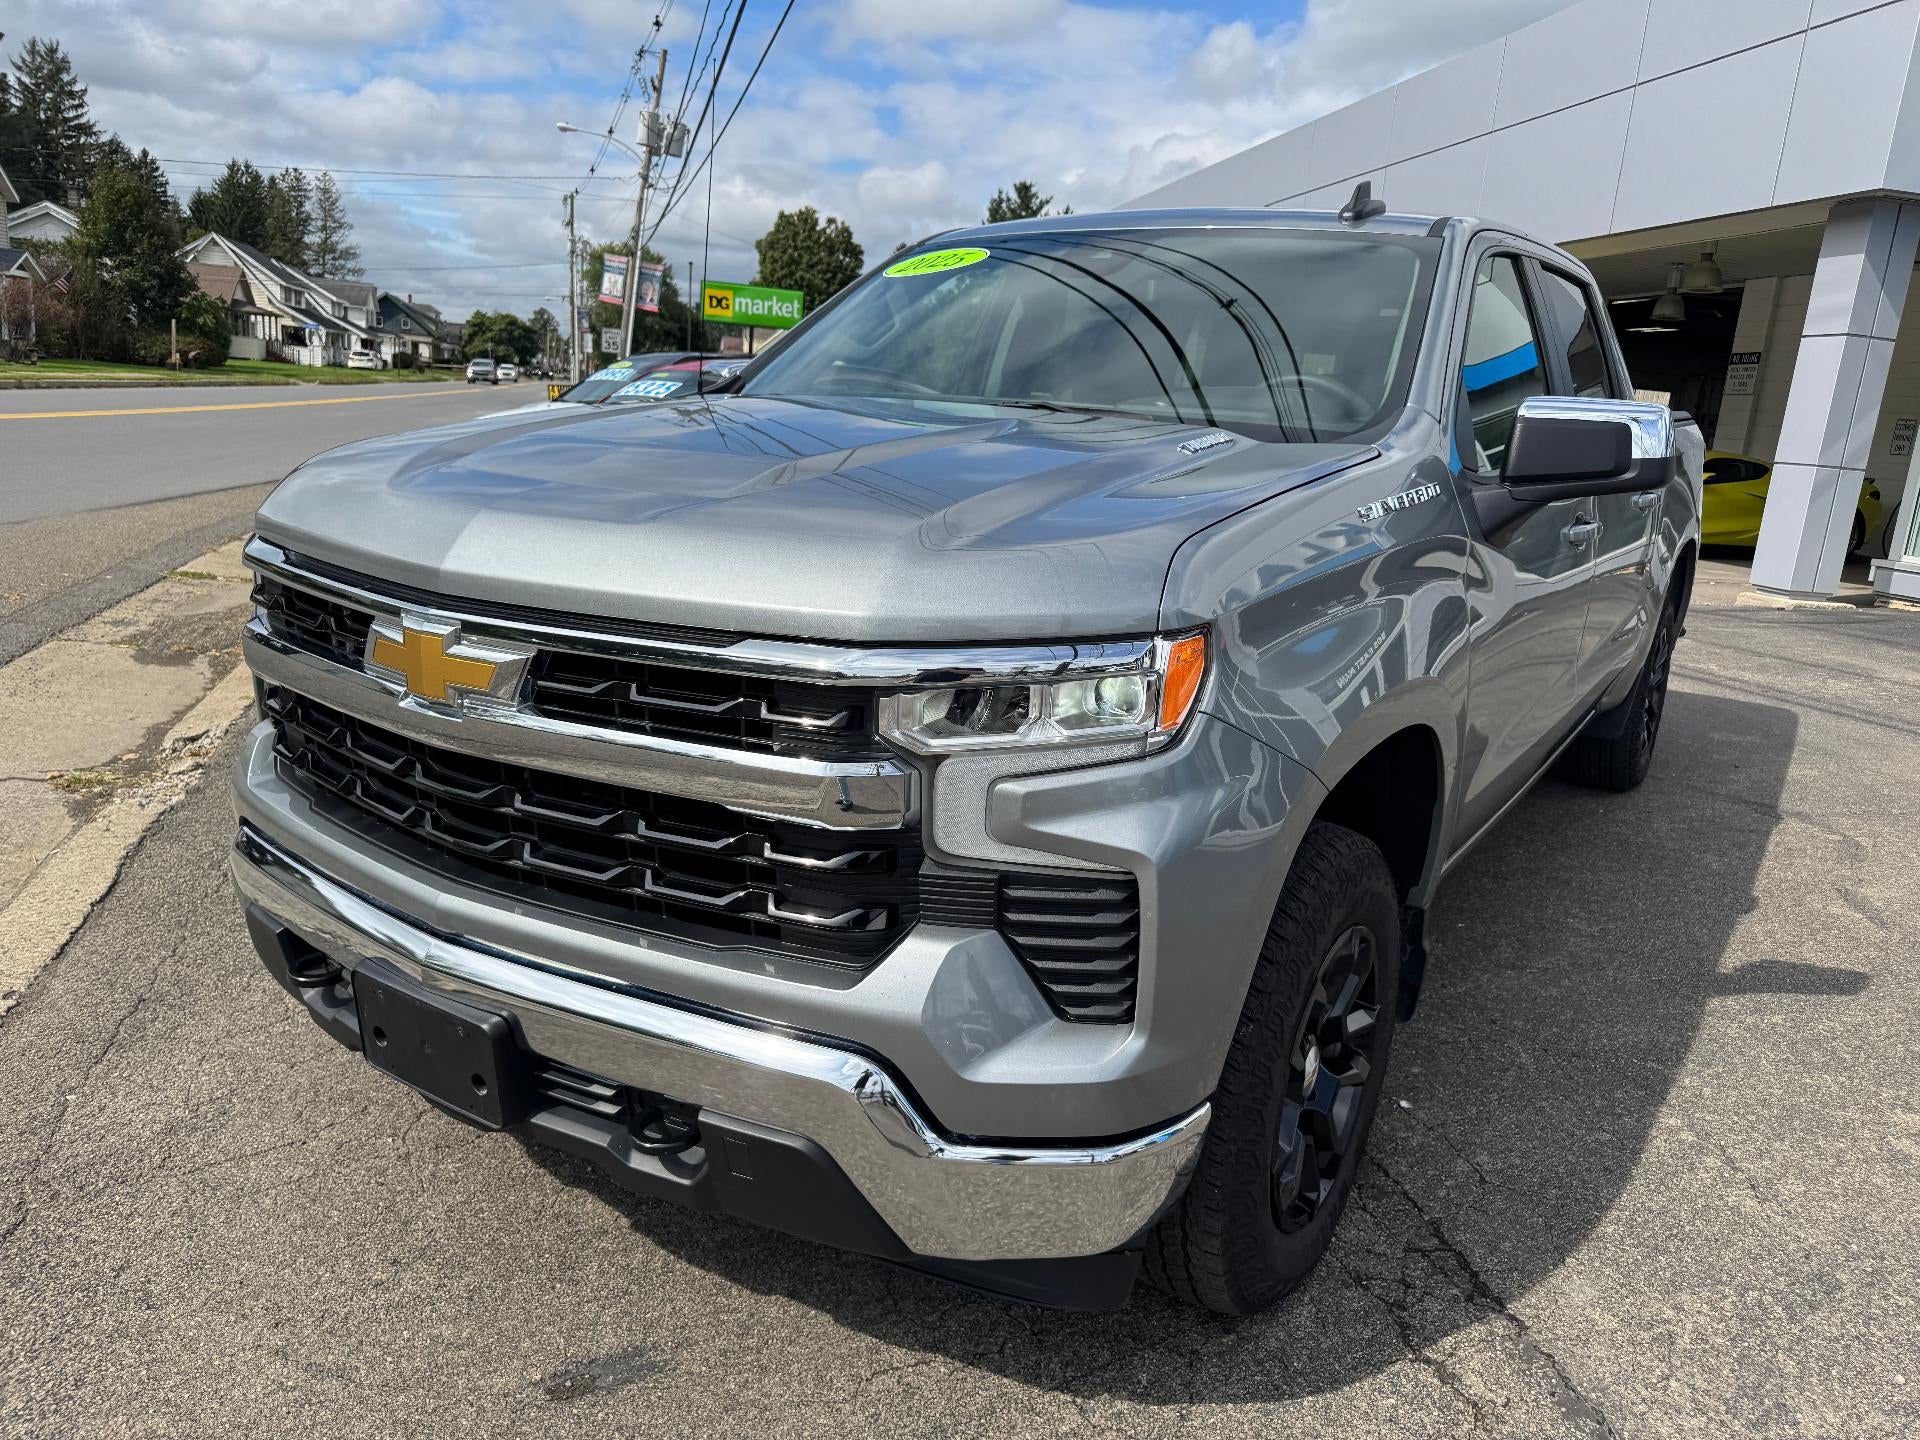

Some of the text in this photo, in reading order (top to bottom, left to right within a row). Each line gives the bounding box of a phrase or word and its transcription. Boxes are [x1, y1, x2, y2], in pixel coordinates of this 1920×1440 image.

[708, 294, 801, 319] DG market
[603, 340, 620, 351] 35
